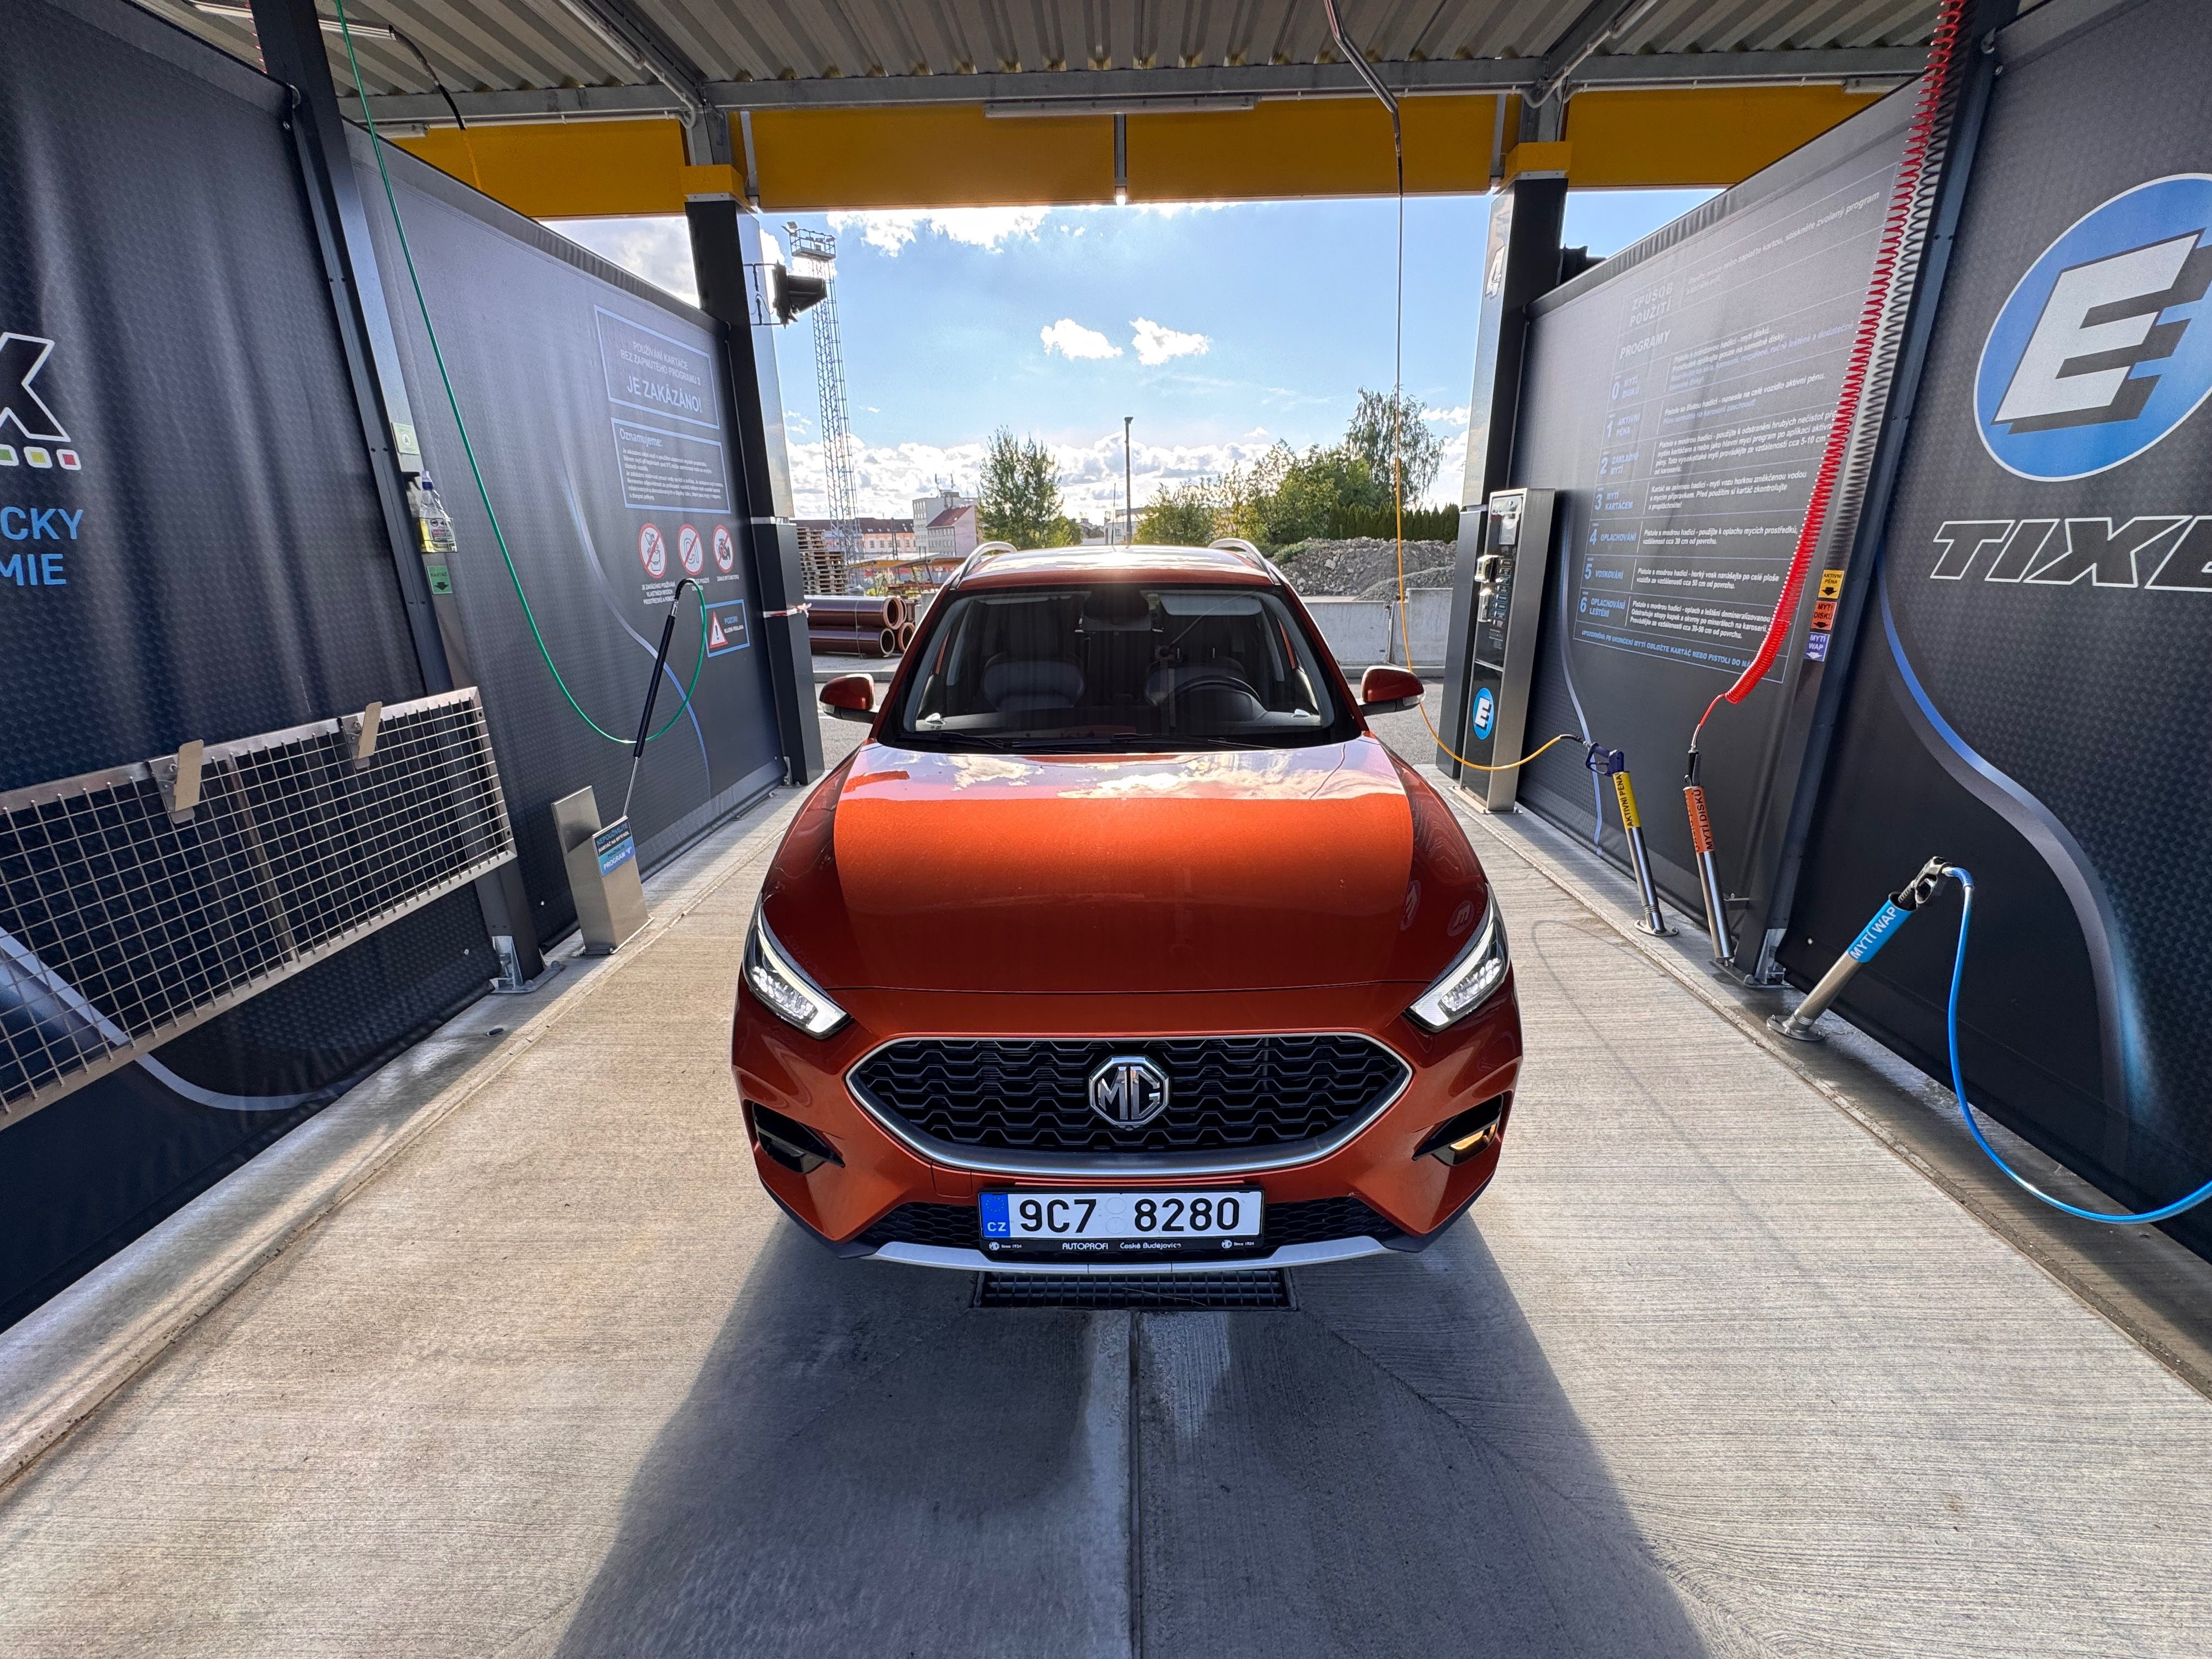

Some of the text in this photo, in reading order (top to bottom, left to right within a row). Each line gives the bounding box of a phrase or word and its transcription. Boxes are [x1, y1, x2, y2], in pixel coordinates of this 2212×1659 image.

[1816, 206, 1844, 227] zvolený
[1845, 191, 1880, 215] program
[1991, 229, 2204, 426] E
[1619, 329, 1671, 360] PROGRAMY
[620, 349, 633, 363] BEZ
[1611, 381, 1620, 400] 0
[1763, 381, 1785, 394] vozidlo
[1785, 375, 1807, 388] aktivní
[1805, 373, 1825, 386] pěnu.
[626, 374, 703, 414] JE ZAKÁZÁNO!
[1605, 419, 1613, 439] 1
[1771, 417, 1797, 429] hrubých
[1797, 412, 1824, 425] nečistot
[619, 428, 663, 448] Oznamujeme:
[1709, 441, 1722, 451] jako
[1751, 433, 1776, 444] program
[1785, 425, 1811, 438] aplikaci
[1799, 436, 1815, 446] 5-10
[1599, 456, 1609, 475] 2
[1733, 476, 1753, 485] horkou
[1753, 473, 1786, 483] změkčenou
[1786, 471, 1807, 479] vodou
[1735, 483, 1788, 494] kartáč zkontrolujte
[1594, 493, 1603, 510] 3
[1604, 499, 1634, 511] KARTÁČEM
[1589, 528, 1598, 545] 4
[1600, 531, 1637, 541] OPLACHOVÁNÍ
[1722, 527, 1743, 537] oplachu
[1743, 526, 1764, 536] mycích
[1583, 563, 1593, 580] 5
[1594, 569, 1624, 579] VOSKOVÁNÍ
[1690, 570, 1705, 579] horký
[1717, 572, 1742, 581] nanášejte
[1762, 573, 1779, 583] ploše
[1713, 582, 1735, 590] povrchu.
[1579, 596, 1588, 613] 6
[1590, 598, 1626, 610] OPLACHOVÁNÍ
[1720, 610, 1771, 623] demineralizovanou
[1719, 631, 1742, 639] povrchu.
[1809, 634, 1826, 642] MYTÍ
[1646, 642, 1669, 652] ODLOŽTE
[1669, 646, 1692, 657] KARTÁČ
[1691, 650, 1708, 660] NEBO
[1707, 653, 1731, 664] PISTOLI
[1731, 657, 1741, 667] DO
[1475, 697, 1491, 729] E
[1692, 789, 1707, 822] DISKŮ
[1700, 825, 1714, 850] MYTÍ
[603, 851, 625, 870] PROGRAM
[1849, 906, 1896, 959] MYTÍ WAP
[1098, 1066, 1160, 1120] MG
[1019, 1197, 1240, 1233] 9C7 8280
[988, 1221, 1007, 1232] CZ
[1062, 1242, 1108, 1250] AUTOPROFI
